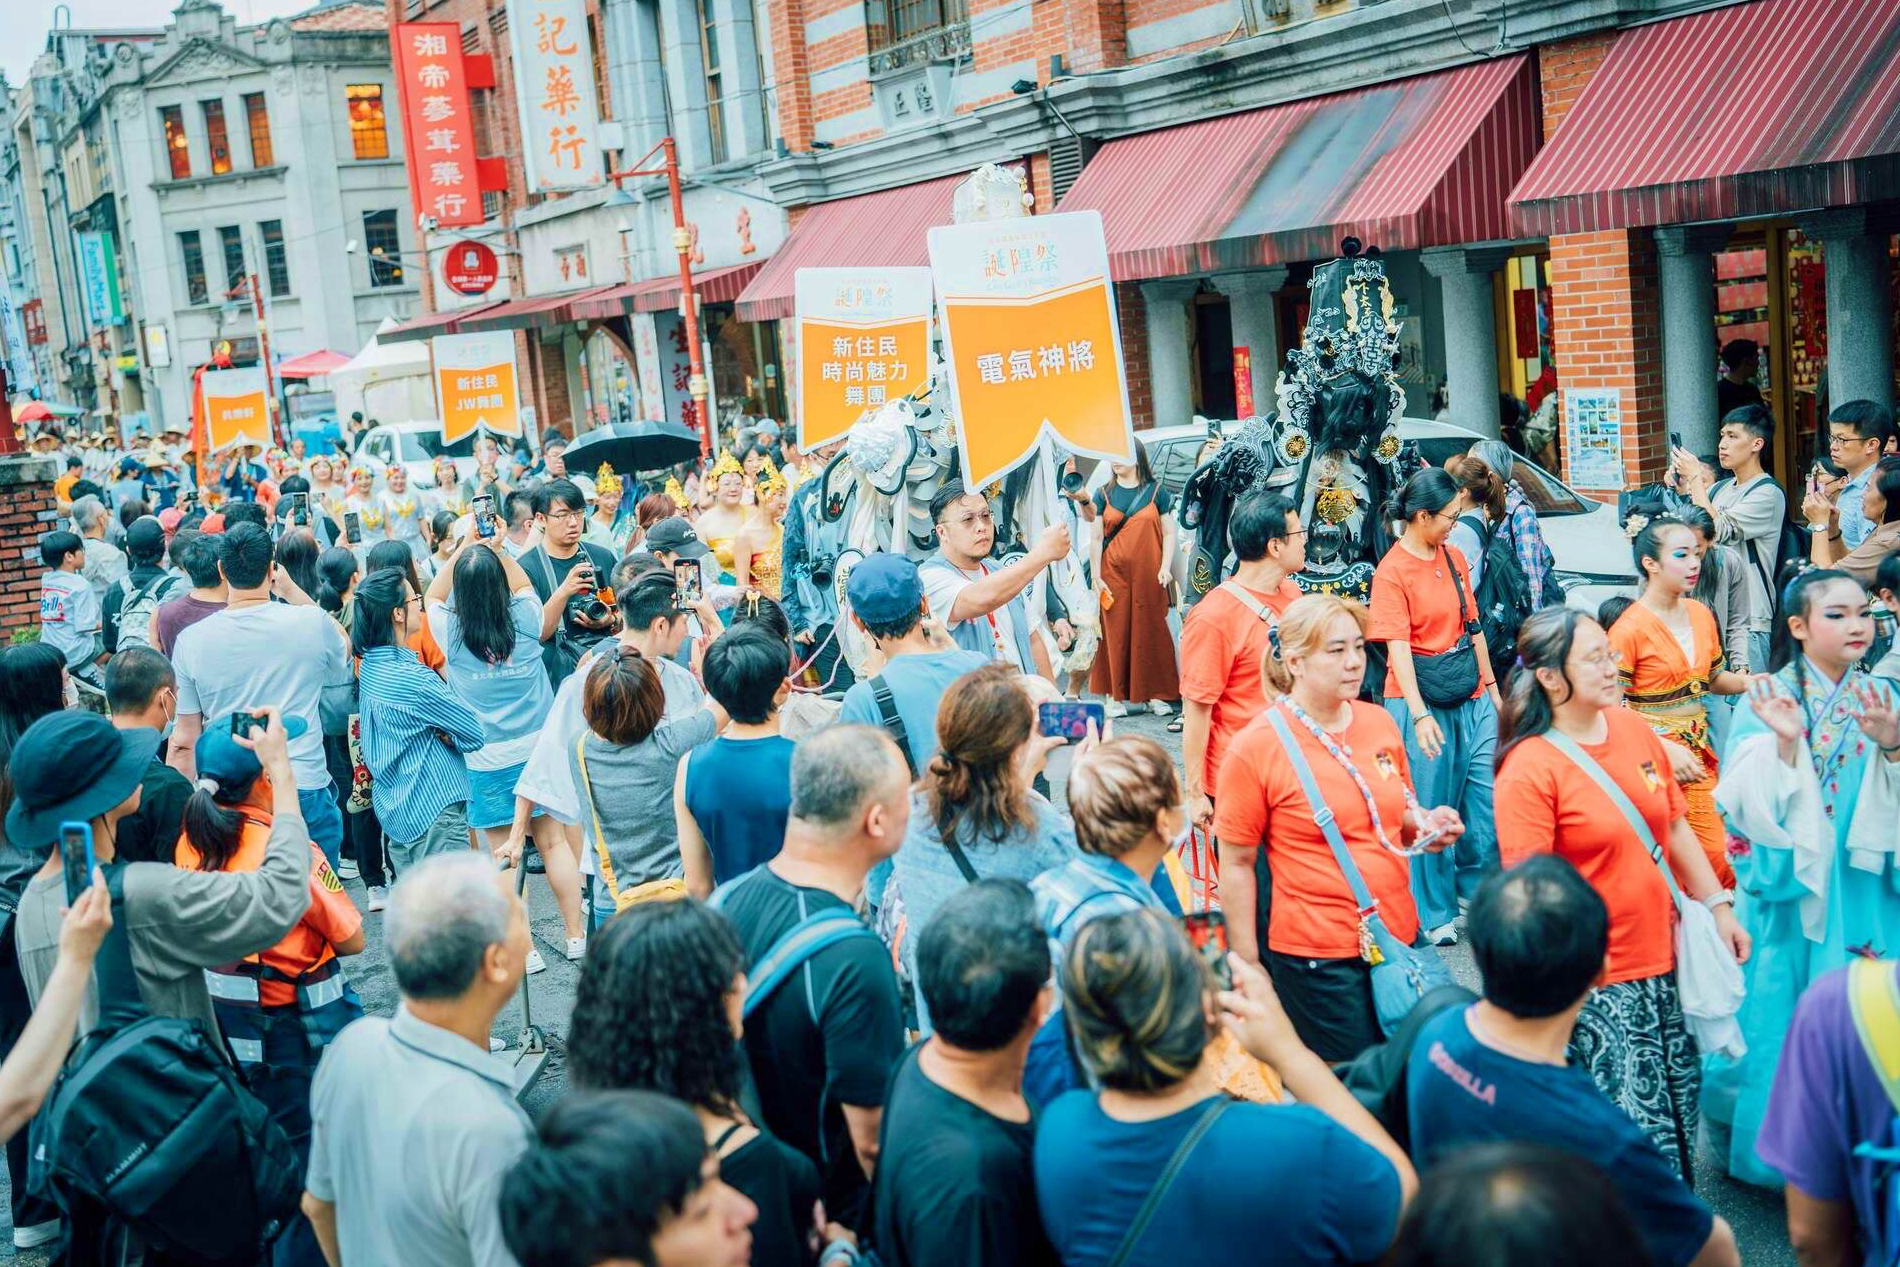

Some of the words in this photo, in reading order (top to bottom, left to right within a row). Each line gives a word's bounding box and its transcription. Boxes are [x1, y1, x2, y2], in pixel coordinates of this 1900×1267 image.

[413, 33, 468, 218] 湘帝蔘茸藥行
[833, 335, 899, 358] 新住民
[821, 360, 909, 383] 時尚魅力
[976, 339, 1096, 385] 電氣神將
[457, 373, 499, 390] 新住民
[844, 385, 888, 407] 舞團
